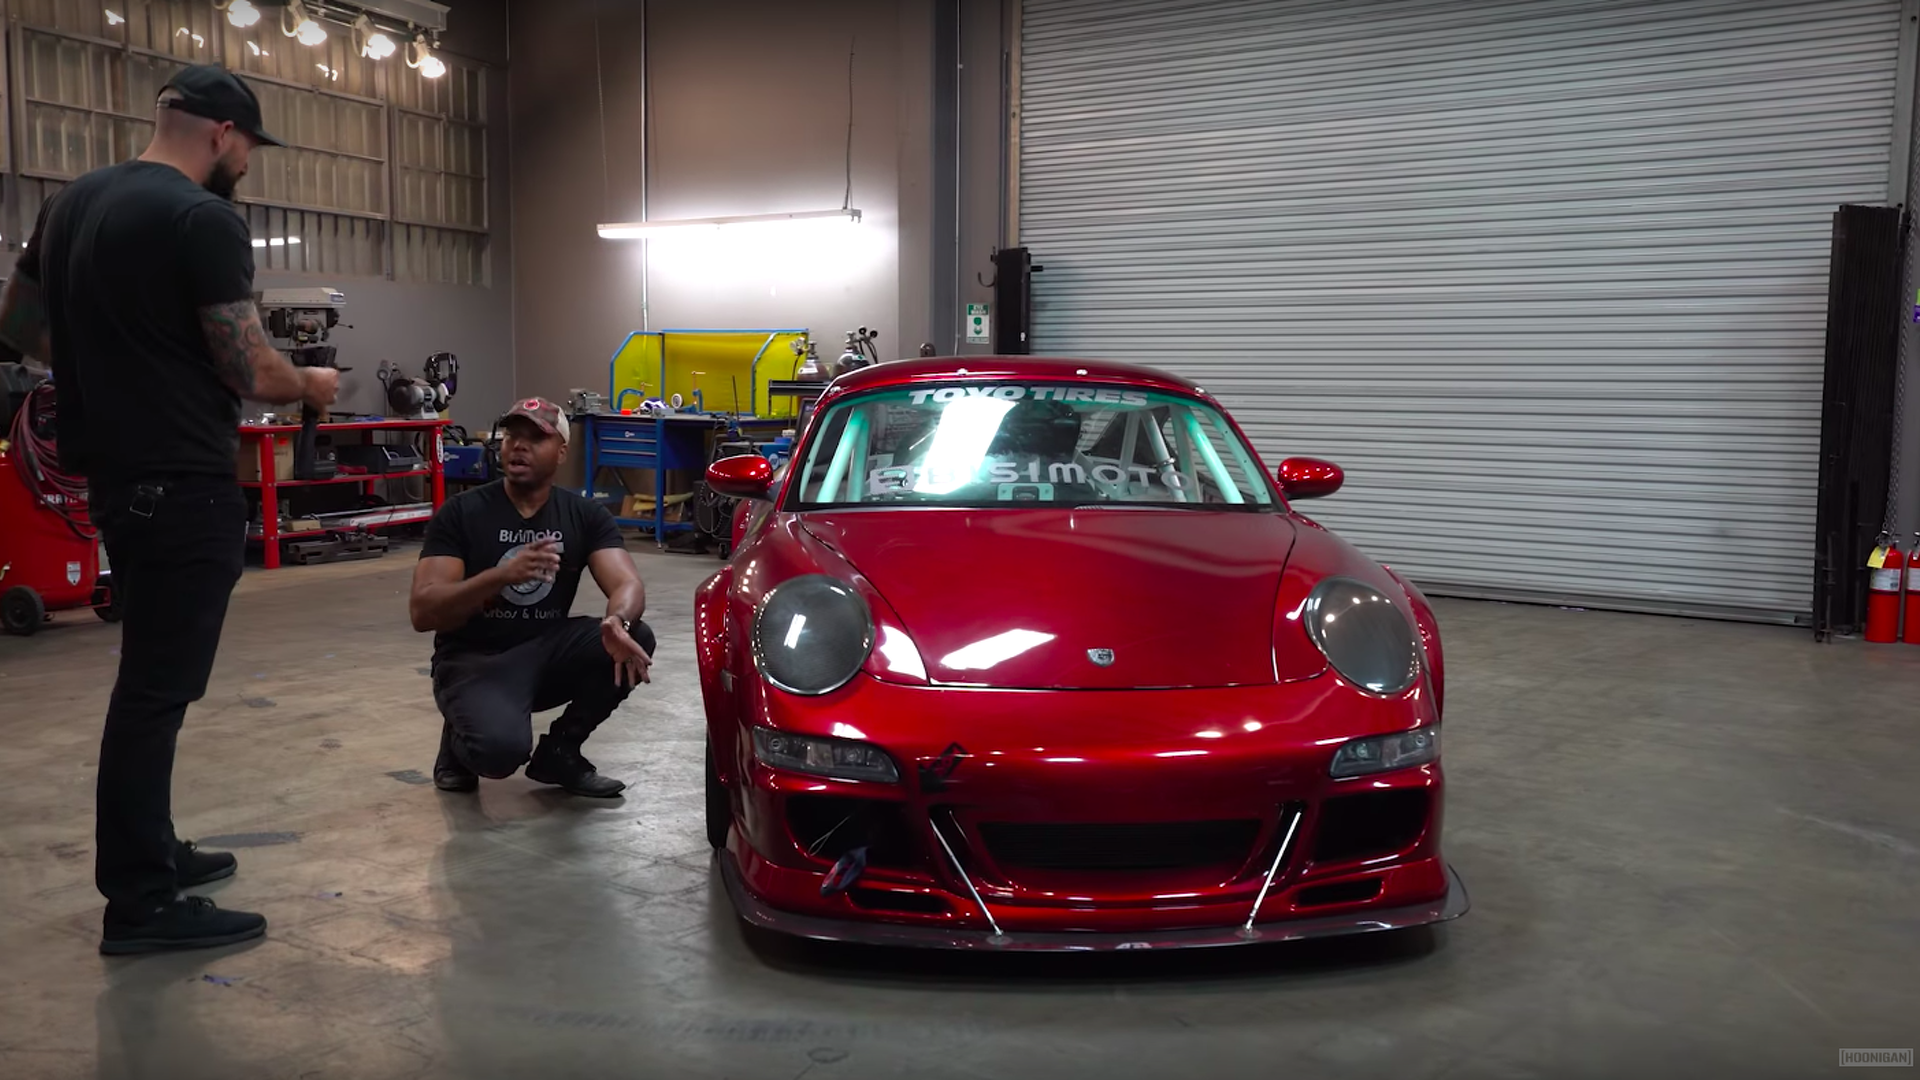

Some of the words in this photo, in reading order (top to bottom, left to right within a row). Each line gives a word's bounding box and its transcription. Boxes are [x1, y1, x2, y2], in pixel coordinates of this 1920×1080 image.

[908, 385, 1027, 405] TOYO
[1029, 387, 1149, 406] TIRES
[484, 608, 519, 619] urbos
[522, 608, 530, 619] &
